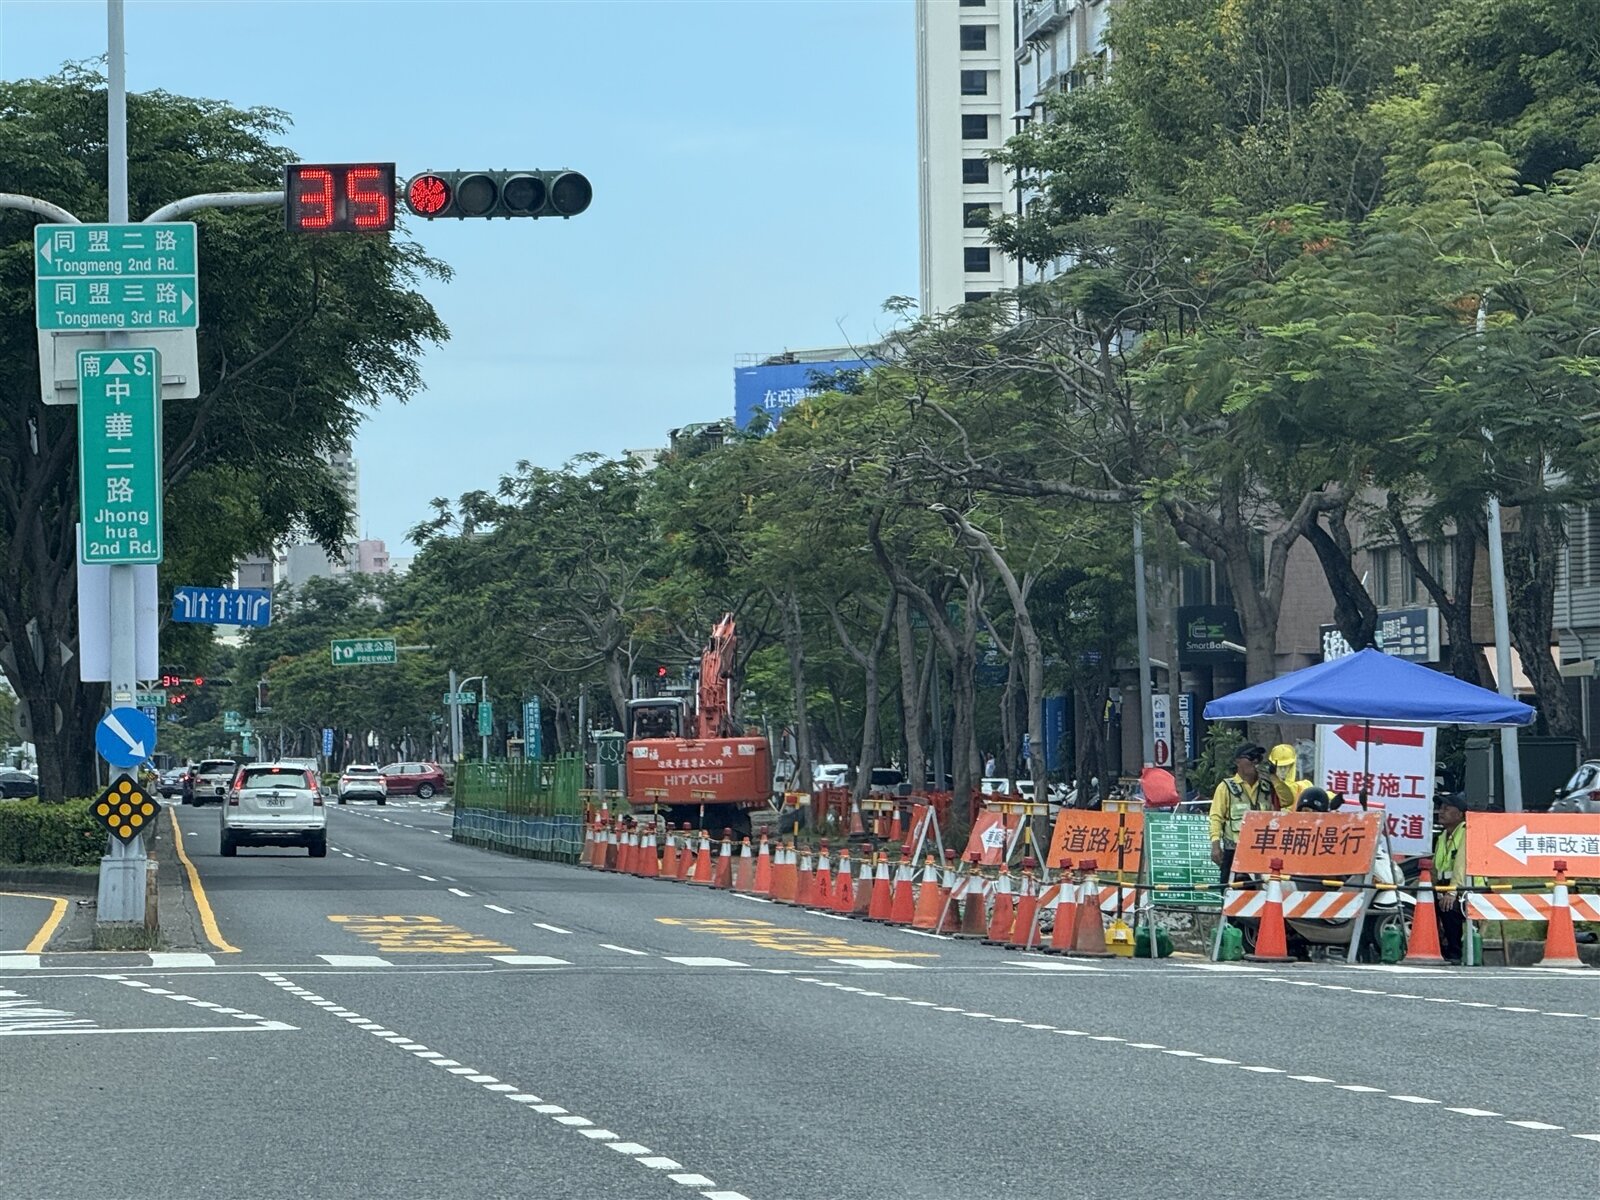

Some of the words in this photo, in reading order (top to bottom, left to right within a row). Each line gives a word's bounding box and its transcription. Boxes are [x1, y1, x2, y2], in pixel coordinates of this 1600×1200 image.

[299, 169, 388, 227] 35
[54, 230, 177, 253] 同盟二路
[55, 258, 122, 275] Tongmeng
[128, 258, 151, 272] 2nd
[158, 257, 179, 272] Rd.
[55, 282, 178, 305] 同盟三路
[56, 311, 125, 328] Tongmeng
[131, 310, 152, 324] 3rd
[158, 310, 179, 324] Rd.
[83, 356, 101, 377] 南
[133, 354, 152, 376] S.
[105, 377, 135, 504] 中華二路
[94, 509, 149, 525] Jhong
[105, 526, 138, 539] hua
[90, 541, 120, 555] 2nd
[129, 540, 156, 554] Rd.
[163, 676, 179, 687] 34
[664, 773, 724, 786] HITACHI
[1326, 769, 1426, 799] 道路施工
[1250, 825, 1366, 856] 車輛慢行
[1515, 836, 1600, 855] 車輛改道
